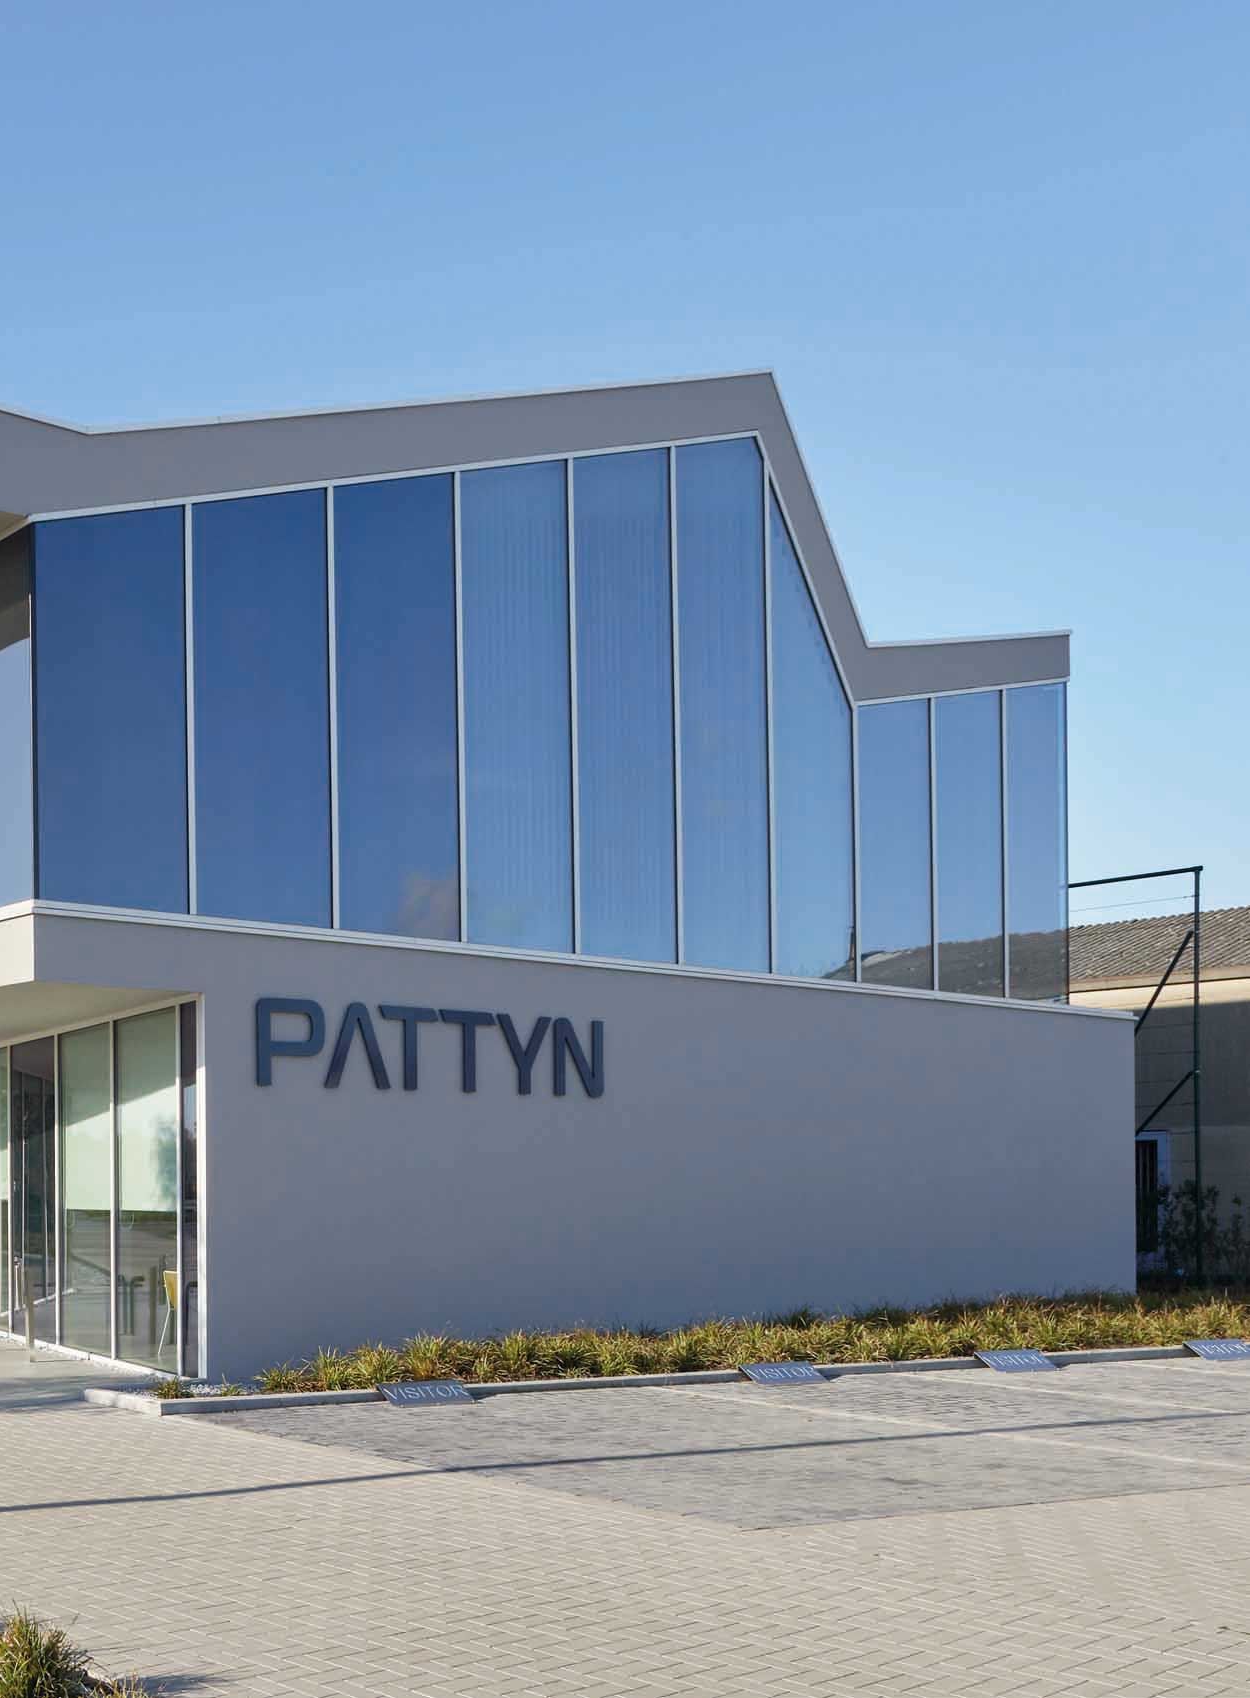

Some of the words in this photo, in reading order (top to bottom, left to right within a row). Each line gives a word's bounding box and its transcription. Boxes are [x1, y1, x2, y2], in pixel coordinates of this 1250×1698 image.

[255, 997, 605, 1098] PATTYN
[746, 1366, 822, 1379] VISITOR
[382, 1384, 470, 1400] VISITOR
